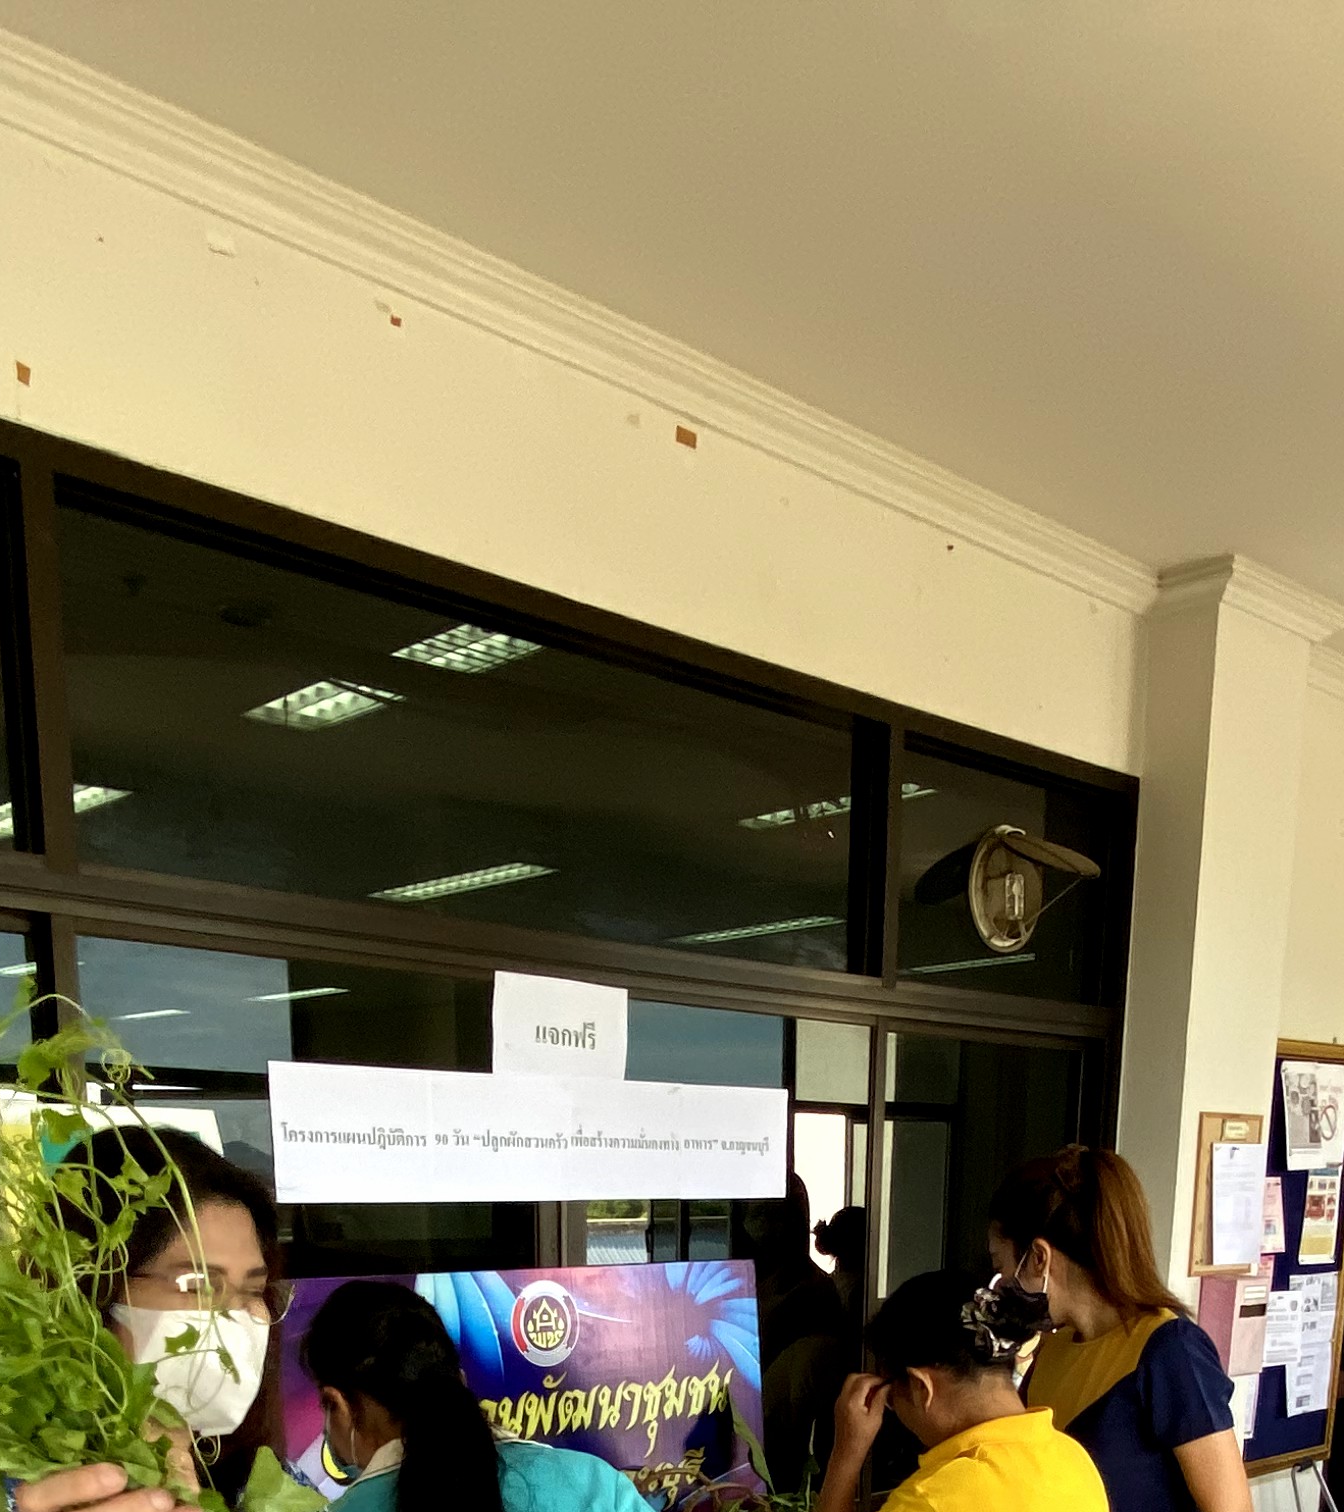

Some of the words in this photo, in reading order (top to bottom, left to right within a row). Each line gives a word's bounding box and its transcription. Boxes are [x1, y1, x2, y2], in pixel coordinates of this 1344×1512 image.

[535, 1022, 598, 1050] แจกฟรี
[434, 1133, 449, 1146] 90
[452, 1128, 470, 1146] วัน
